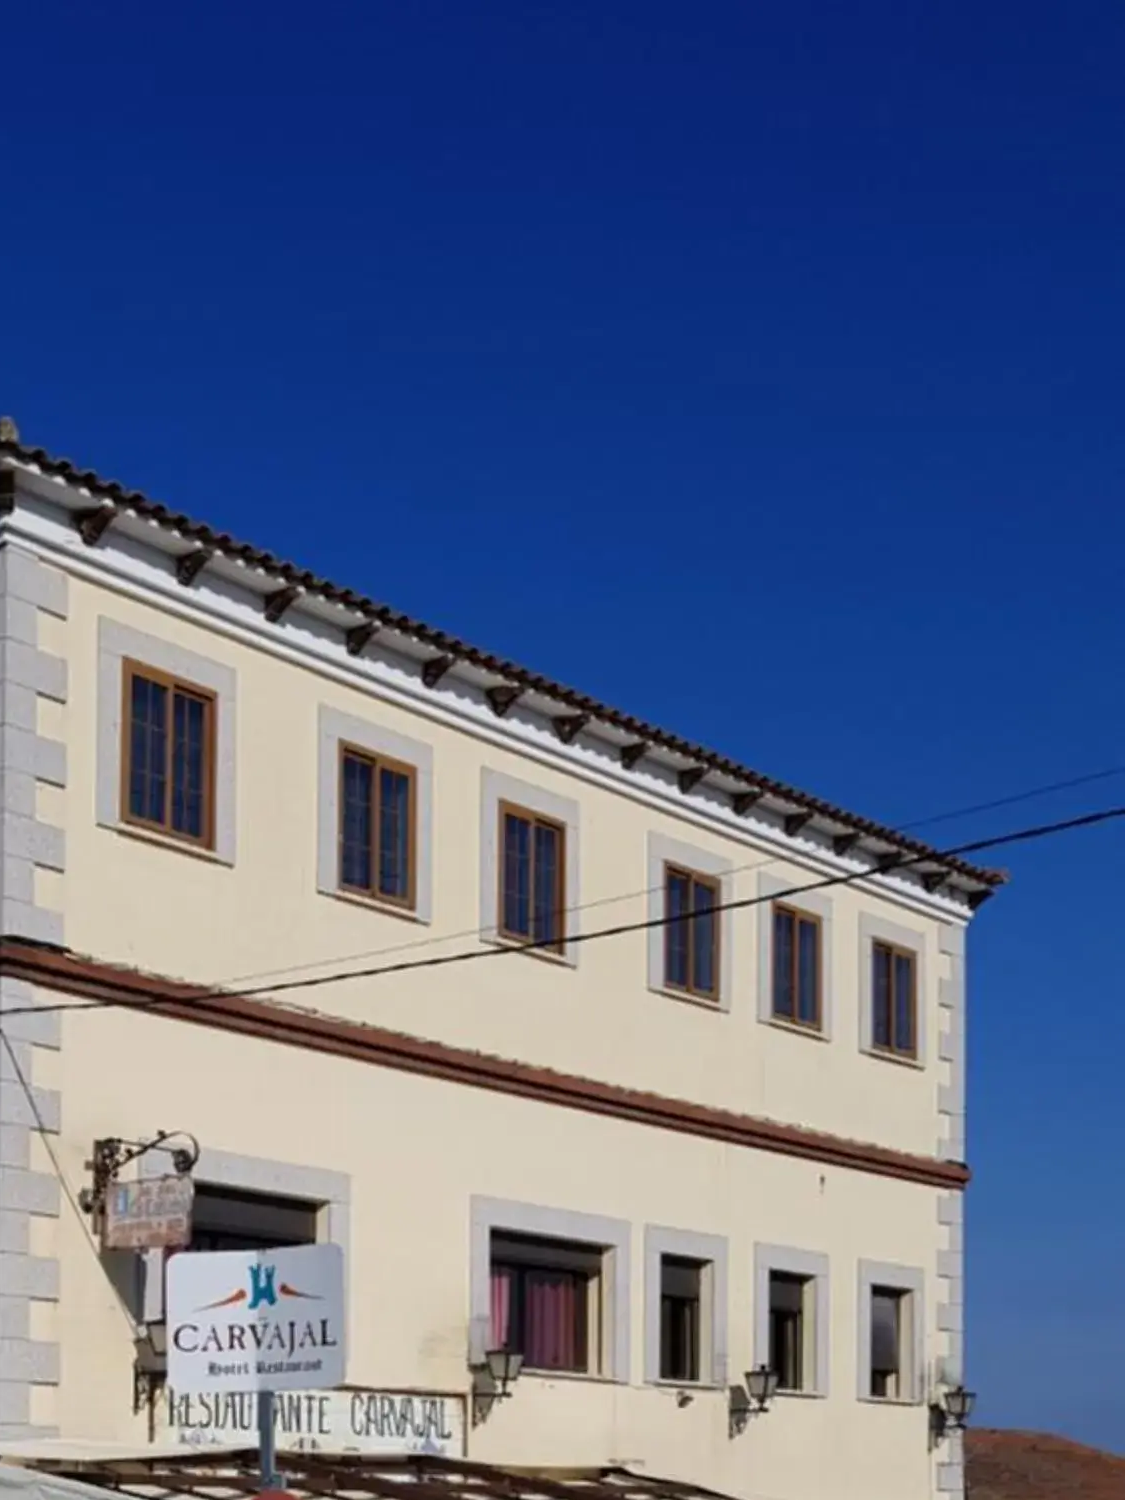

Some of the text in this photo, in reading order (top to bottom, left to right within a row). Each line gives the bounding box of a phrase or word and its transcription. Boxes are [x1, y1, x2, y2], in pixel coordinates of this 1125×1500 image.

[173, 1318, 338, 1359] CARVAJAL
[207, 1360, 250, 1376] Hotel
[167, 1386, 452, 1440] RESTAUANTE CARVAJAL
